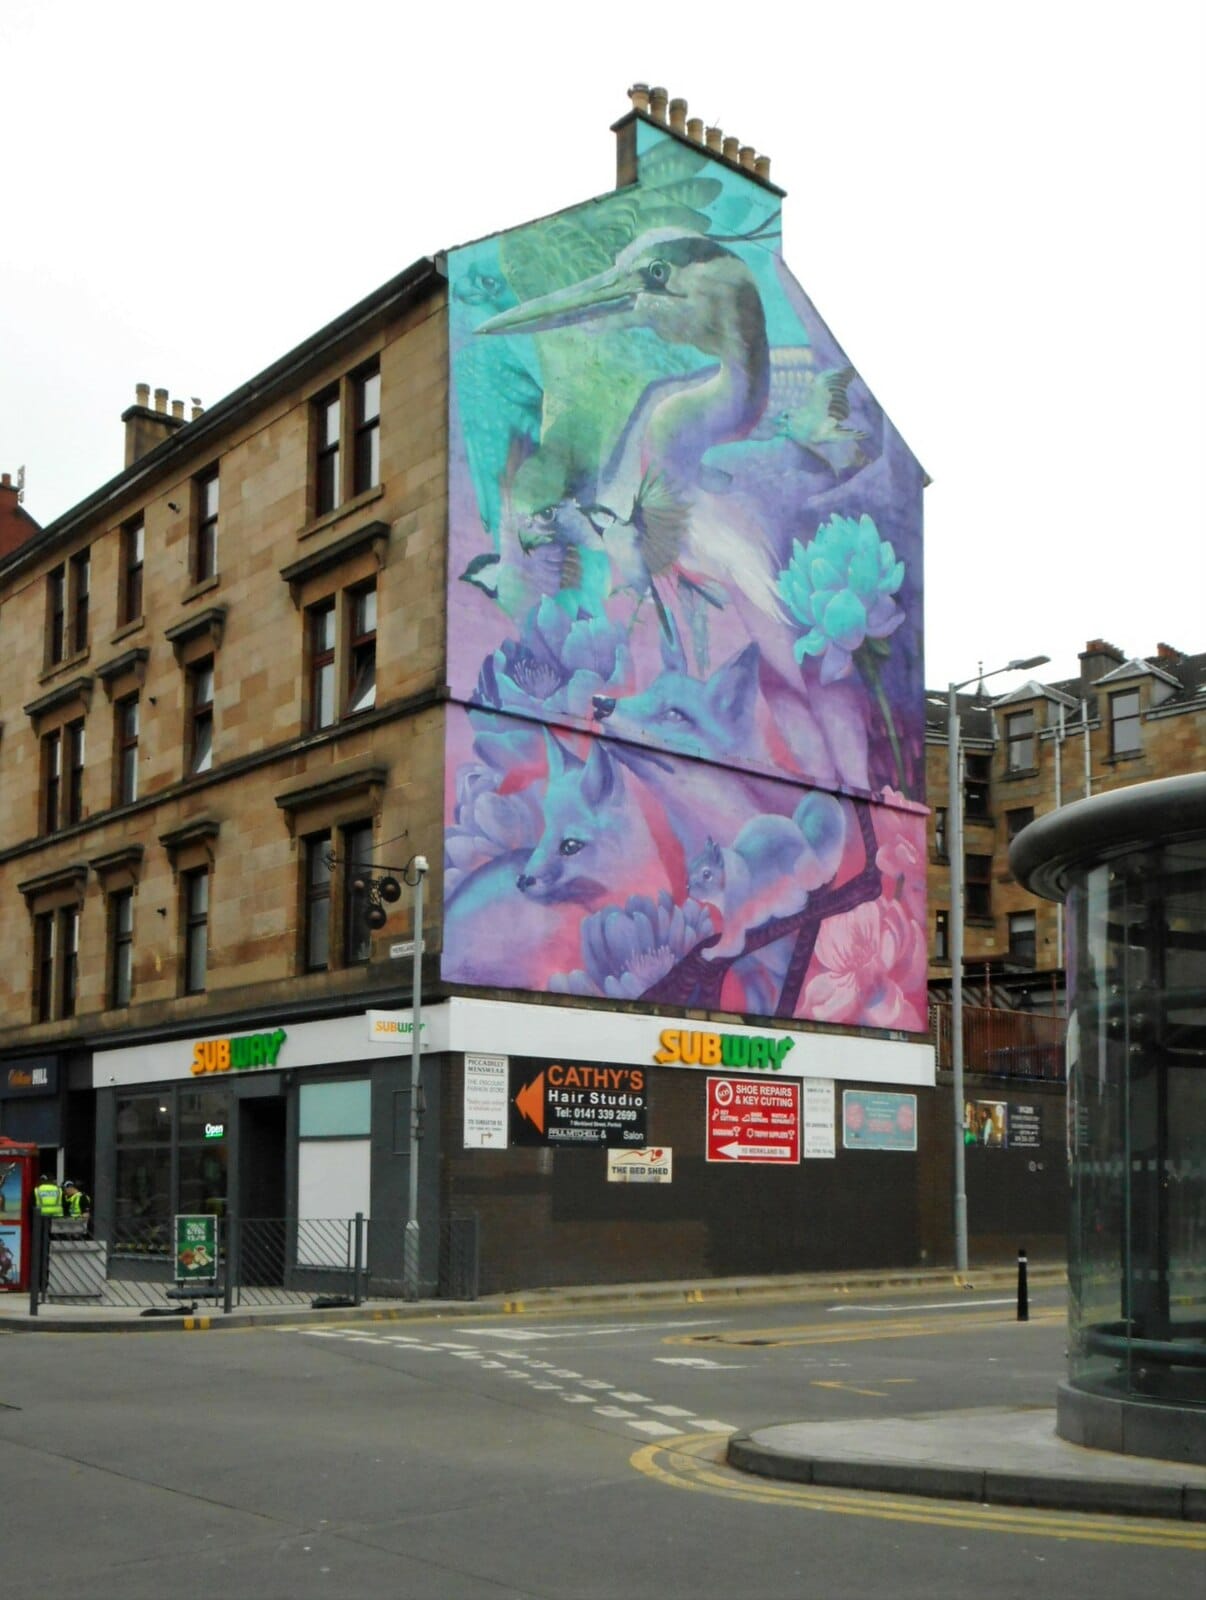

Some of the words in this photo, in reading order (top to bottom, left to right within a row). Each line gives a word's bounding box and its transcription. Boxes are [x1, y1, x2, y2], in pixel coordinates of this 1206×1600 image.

[191, 1028, 287, 1075] SUBWAY
[653, 1029, 795, 1070] SUBWAY
[32, 1068, 48, 1085] HILL
[548, 1065, 644, 1090] CATHY'S
[548, 1090, 584, 1103] Hair
[590, 1092, 643, 1106] Studio
[736, 1085, 759, 1095] SHOE
[760, 1086, 792, 1098] REPAIRS
[735, 1095, 742, 1105] &
[743, 1096, 760, 1106] KEY
[761, 1097, 793, 1108] CUTTING
[555, 1107, 572, 1118] Tel:
[574, 1108, 596, 1119] 0141
[598, 1109, 614, 1120] 339
[205, 1123, 224, 1135] Open
[600, 1130, 607, 1139] &
[623, 1131, 644, 1140] Salon
